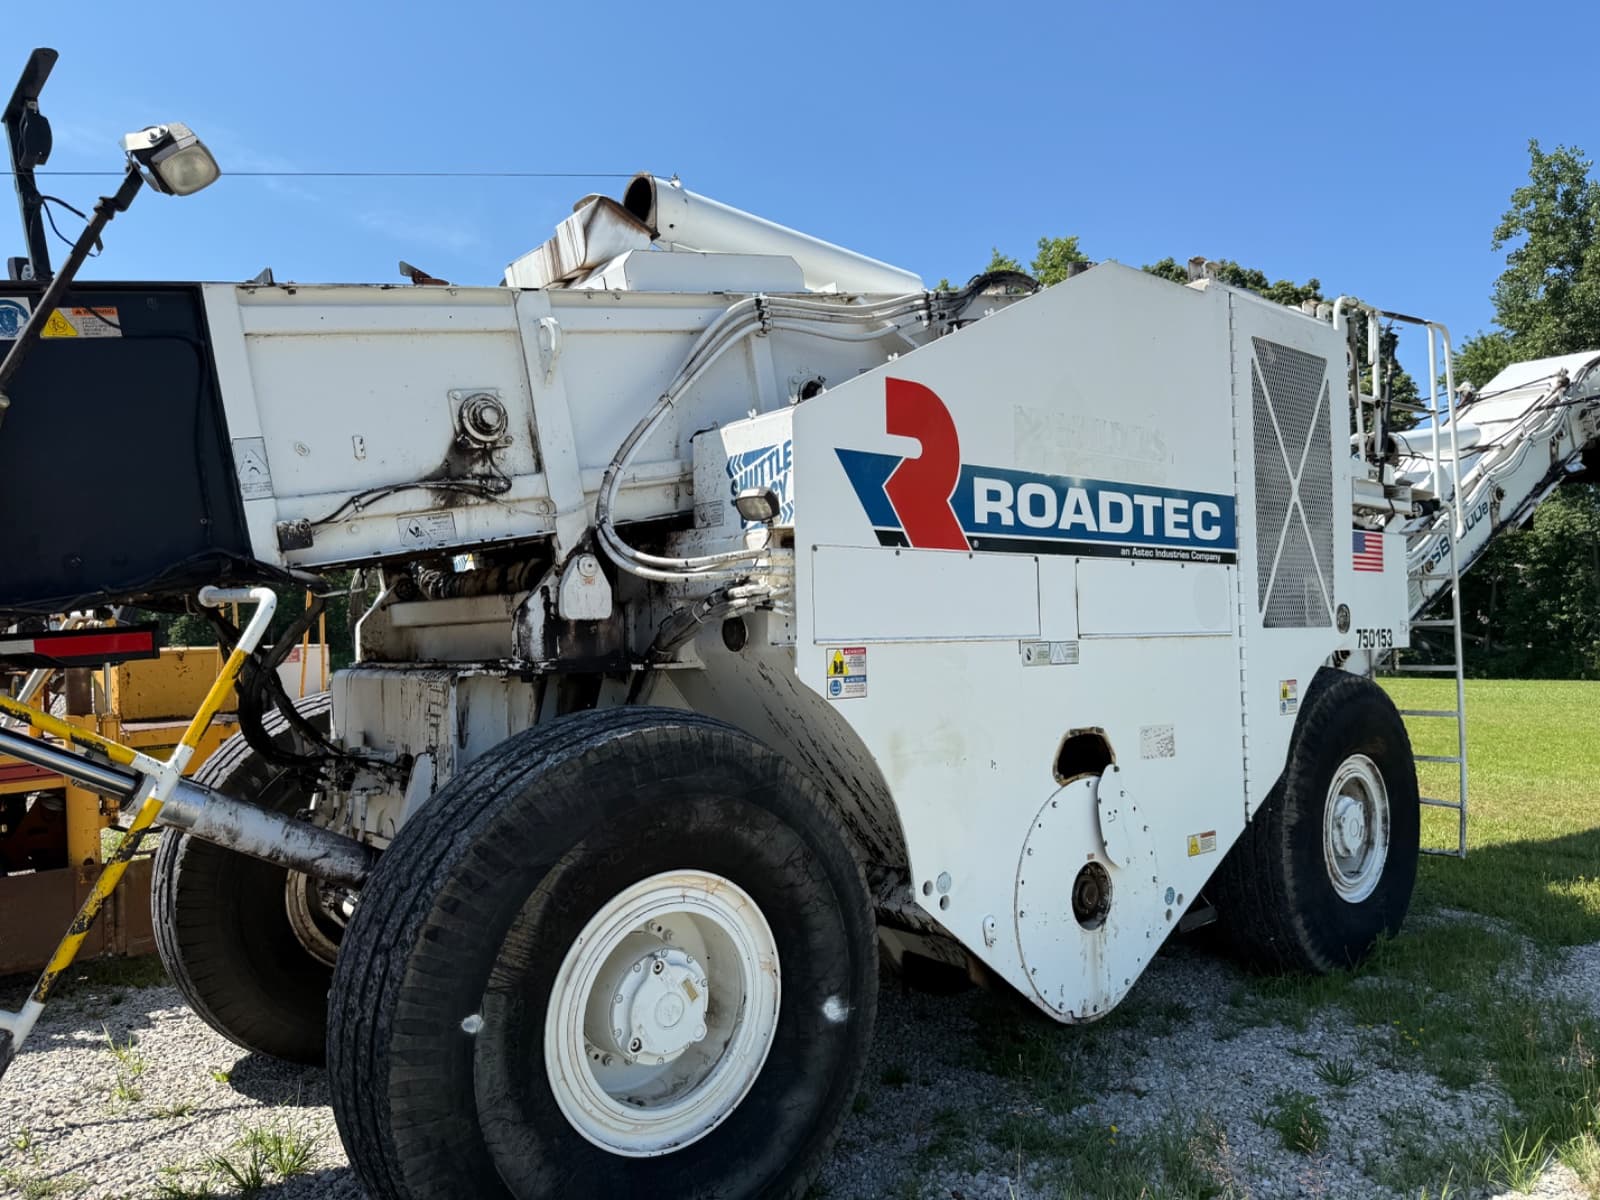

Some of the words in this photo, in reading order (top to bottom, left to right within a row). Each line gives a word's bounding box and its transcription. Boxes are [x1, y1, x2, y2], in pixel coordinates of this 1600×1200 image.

[973, 476, 1221, 541] ROADTEC
[1120, 548, 1130, 556] an
[1132, 547, 1154, 557] Astec
[1155, 549, 1190, 560] Industries
[1191, 551, 1221, 563] Company
[1356, 628, 1393, 648] 750153
